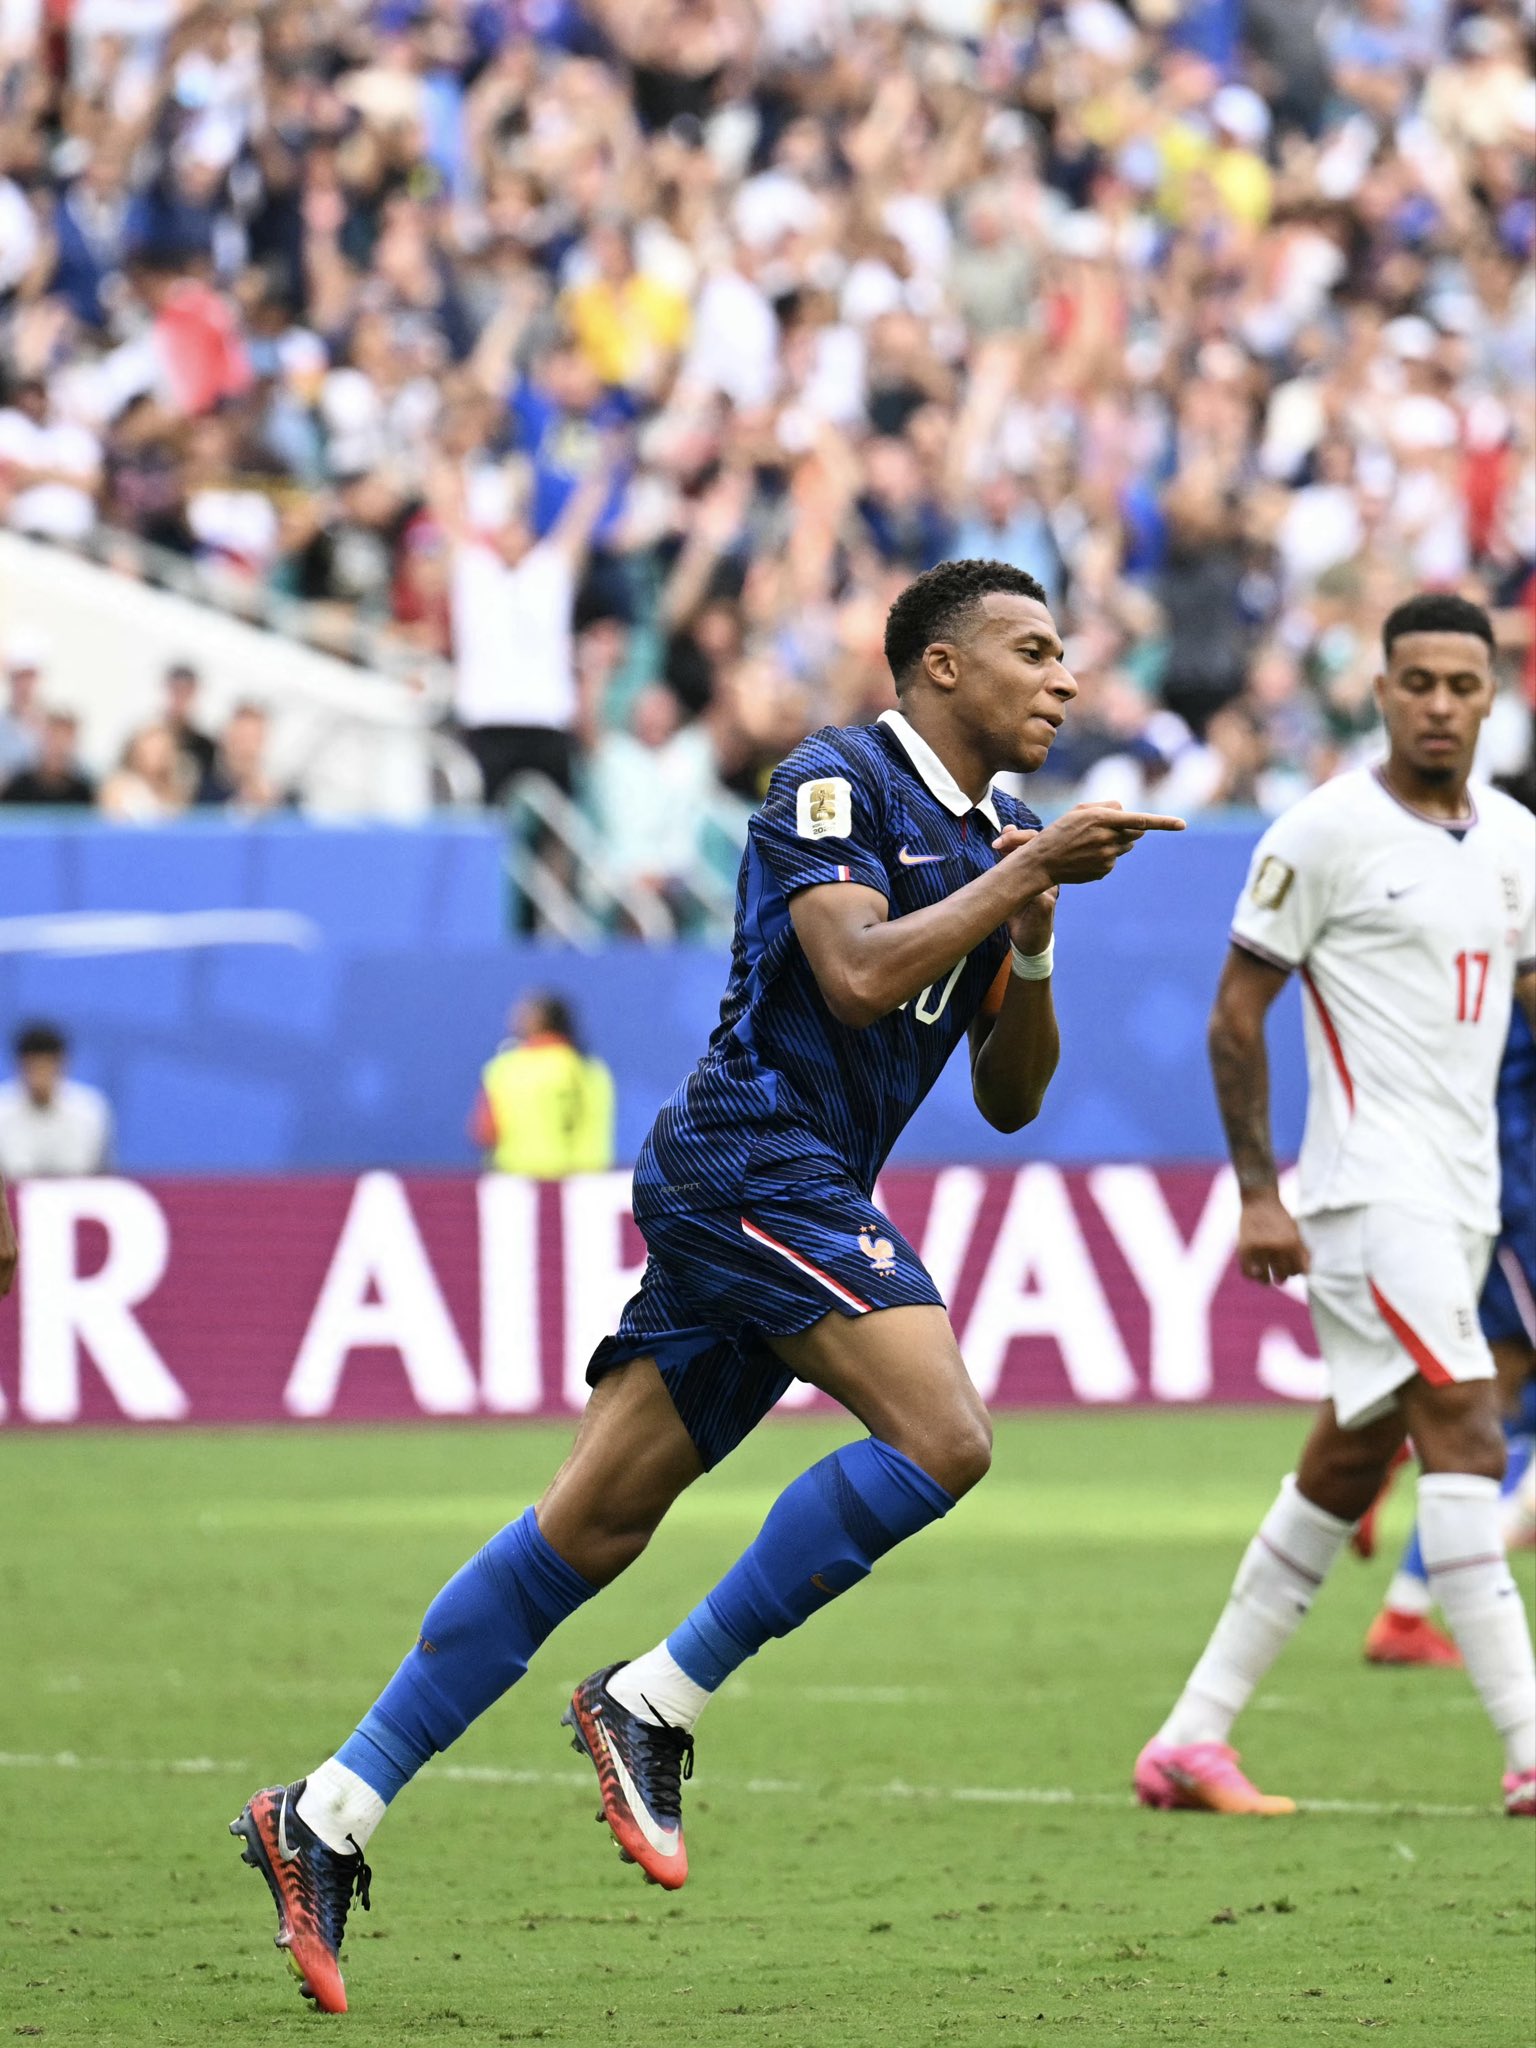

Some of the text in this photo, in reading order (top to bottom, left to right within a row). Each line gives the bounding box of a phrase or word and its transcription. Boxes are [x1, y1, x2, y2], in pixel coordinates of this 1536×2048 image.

[898, 955, 967, 1025] 0
[1454, 950, 1491, 1024] 17
[0, 1175, 192, 1423] R
